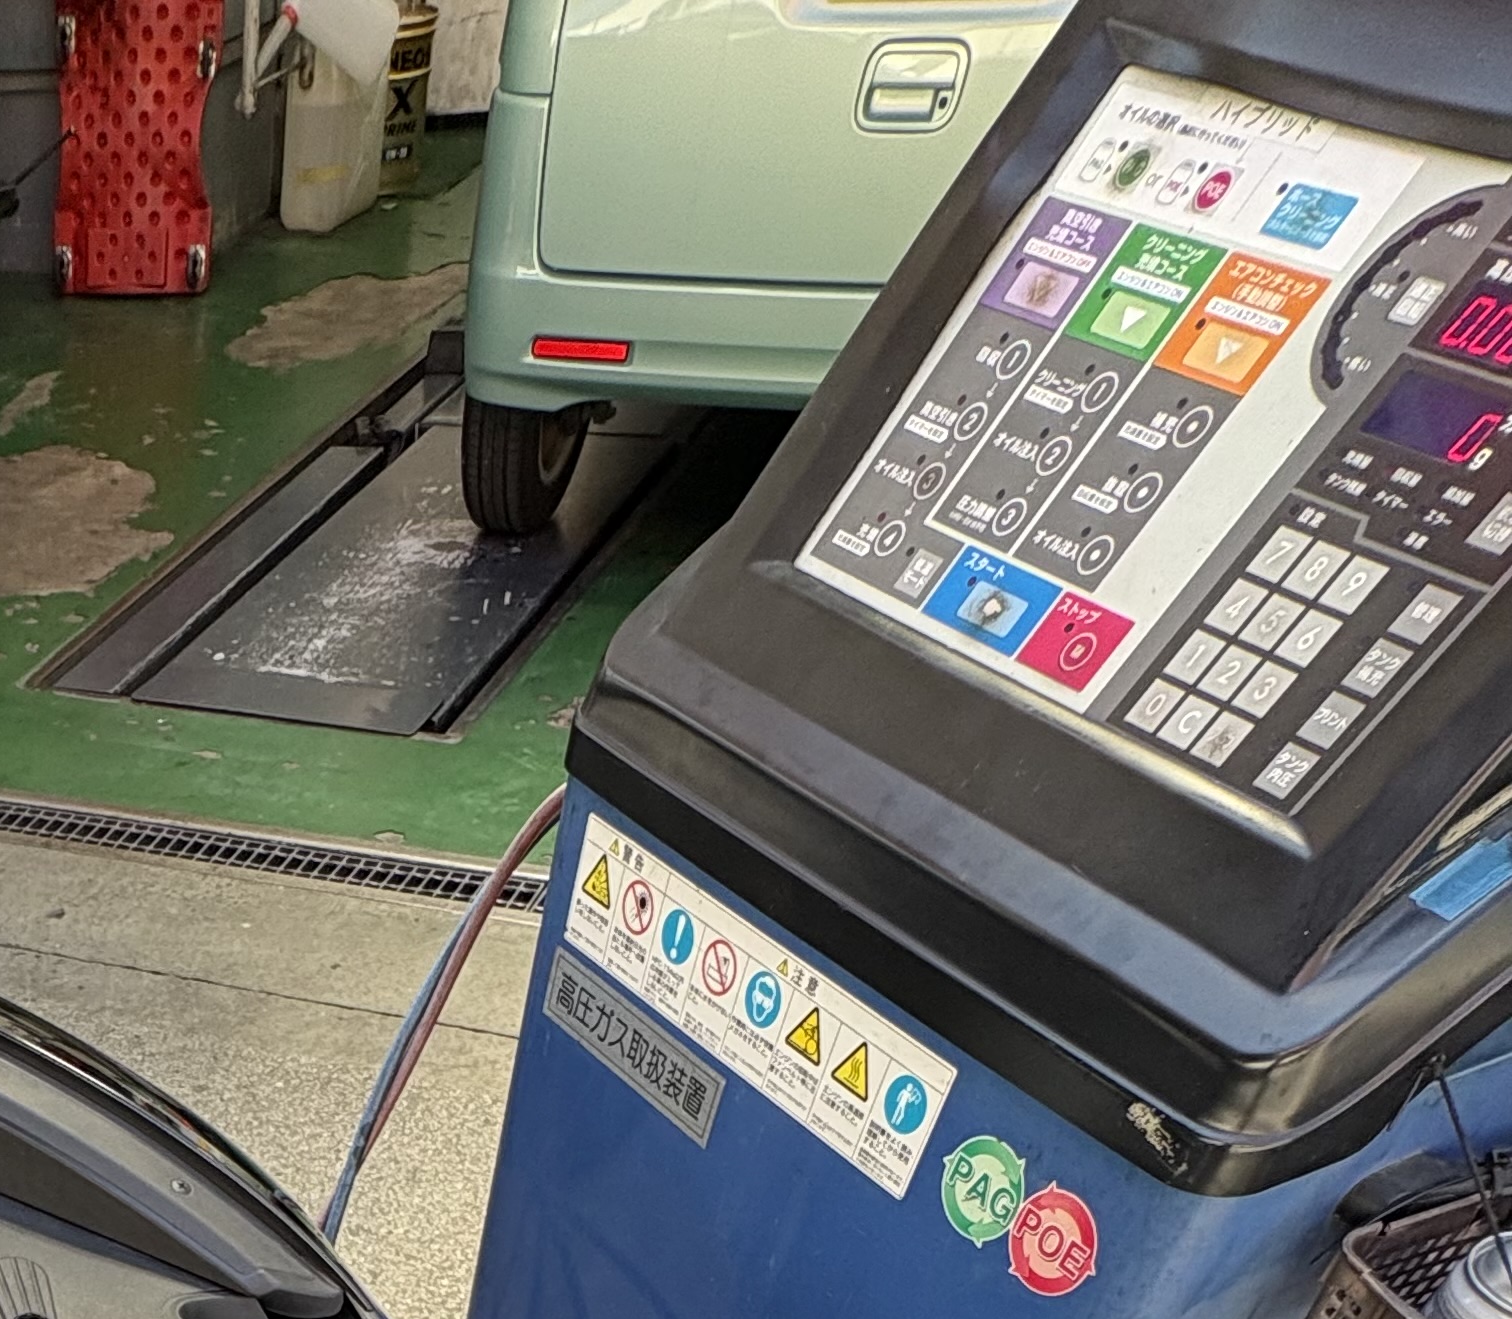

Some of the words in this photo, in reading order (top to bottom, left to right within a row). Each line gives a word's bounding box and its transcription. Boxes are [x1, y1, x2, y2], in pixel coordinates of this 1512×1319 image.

[1210, 99, 1322, 142] ハイブリッド
[1146, 171, 1162, 189] or
[1201, 179, 1228, 202] POE
[1141, 229, 1209, 268] クリーニング
[1227, 255, 1320, 303] エアコンチェック
[1005, 349, 1022, 369] 1
[1033, 366, 1088, 400] クリーニング
[1090, 381, 1108, 402] 1
[960, 409, 980, 432] 2
[990, 428, 1042, 463] オイル注入
[1447, 412, 1504, 463] 0
[1043, 445, 1062, 466] 2
[871, 455, 919, 487] オイル注入
[920, 471, 937, 491] 3
[1371, 489, 1409, 510] タイマー
[999, 507, 1017, 527] 3
[1422, 508, 1453, 527] エラー
[881, 528, 898, 547] 4
[1030, 526, 1083, 562] オイル注入
[1265, 539, 1296, 566] 7
[962, 550, 1009, 583] スタート
[1303, 556, 1329, 583] 8
[1341, 571, 1368, 598] 9
[1056, 595, 1102, 628] ストップ
[1224, 594, 1252, 620] 4
[1260, 609, 1287, 635] 5
[1295, 624, 1323, 651] 6
[1187, 644, 1206, 669] 1
[1364, 647, 1402, 671] タンク
[1216, 660, 1242, 686] 2
[1252, 675, 1279, 701] 3
[1145, 693, 1167, 717] 0
[1177, 709, 1203, 735] C
[1312, 706, 1350, 732] プリント
[1274, 750, 1311, 774] タンク
[1265, 766, 1297, 789] 内圧
[789, 964, 821, 999] 注意
[554, 968, 709, 1126] 高圧ガス取扱装置
[947, 1151, 1016, 1225] PAG
[1013, 1204, 1091, 1281] POE
